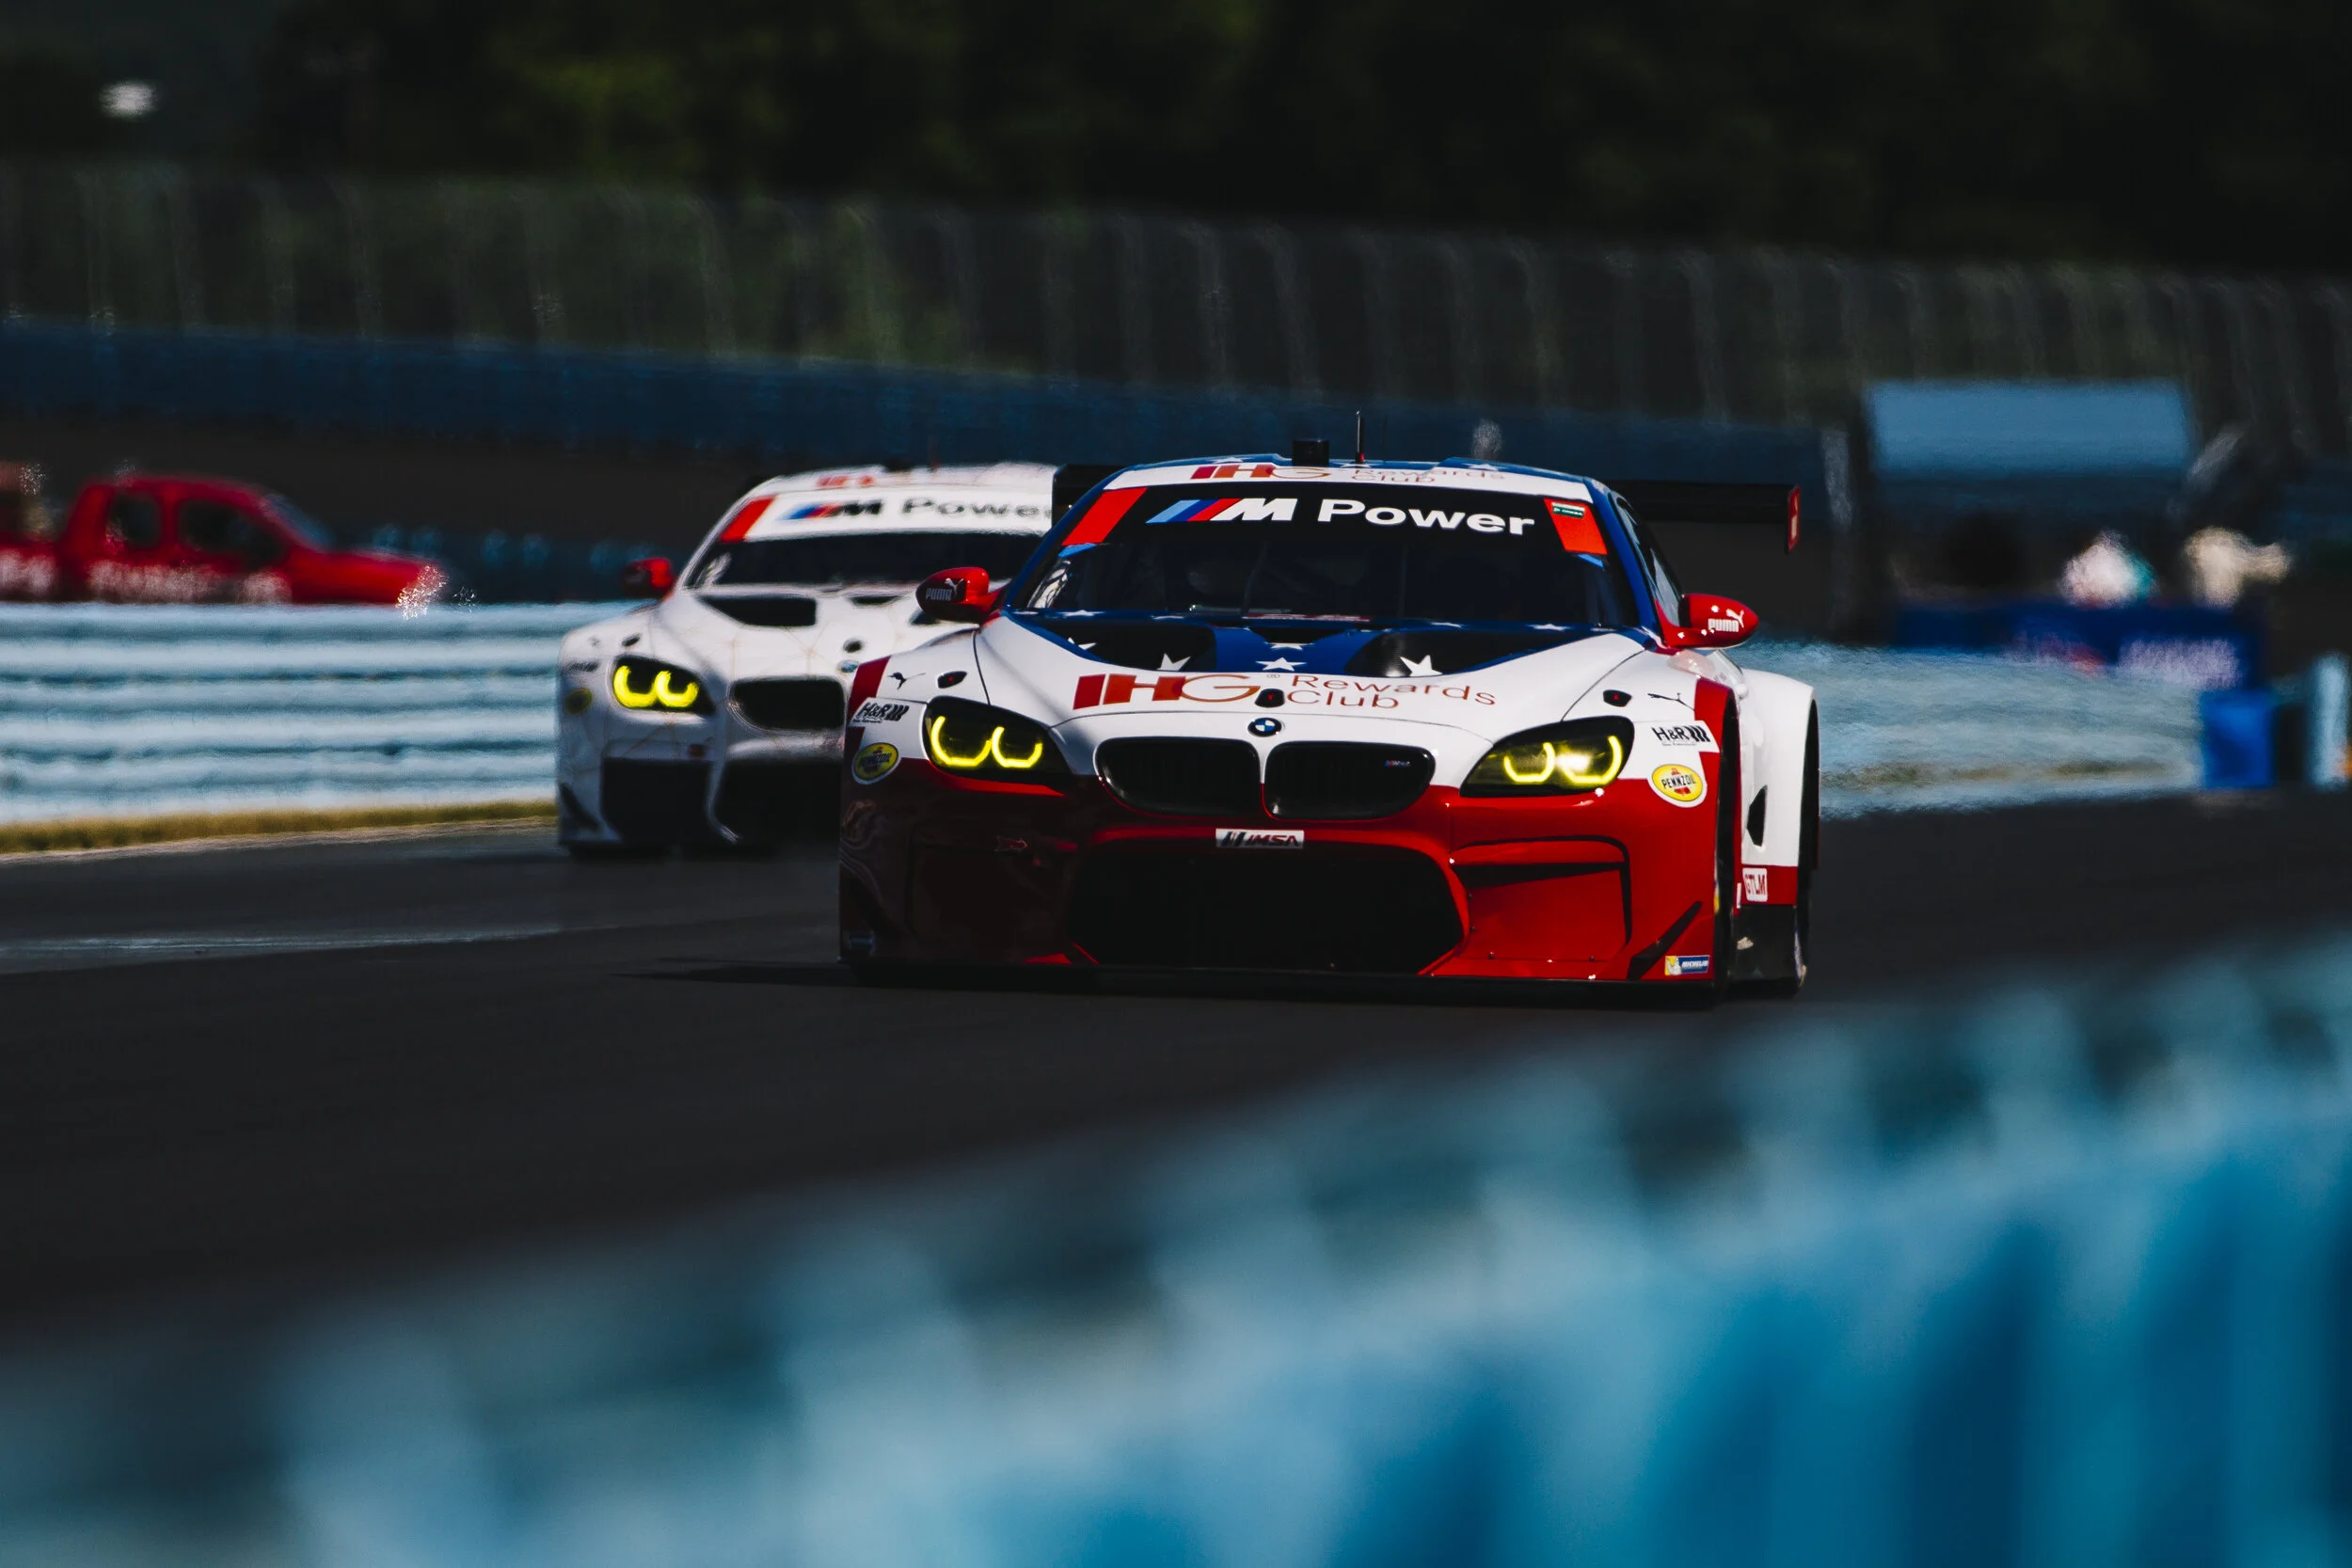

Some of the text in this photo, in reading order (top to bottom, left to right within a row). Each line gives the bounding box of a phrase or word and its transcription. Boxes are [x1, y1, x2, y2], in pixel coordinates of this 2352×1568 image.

[1190, 464, 1332, 480] IHG
[1210, 498, 1535, 535] M Power
[1073, 673, 1497, 710] IHG Rewards
[1286, 689, 1400, 709] Club
[855, 702, 892, 718] H&R
[1651, 725, 1691, 741] H&R
[1661, 774, 1697, 789] PENNZOIL
